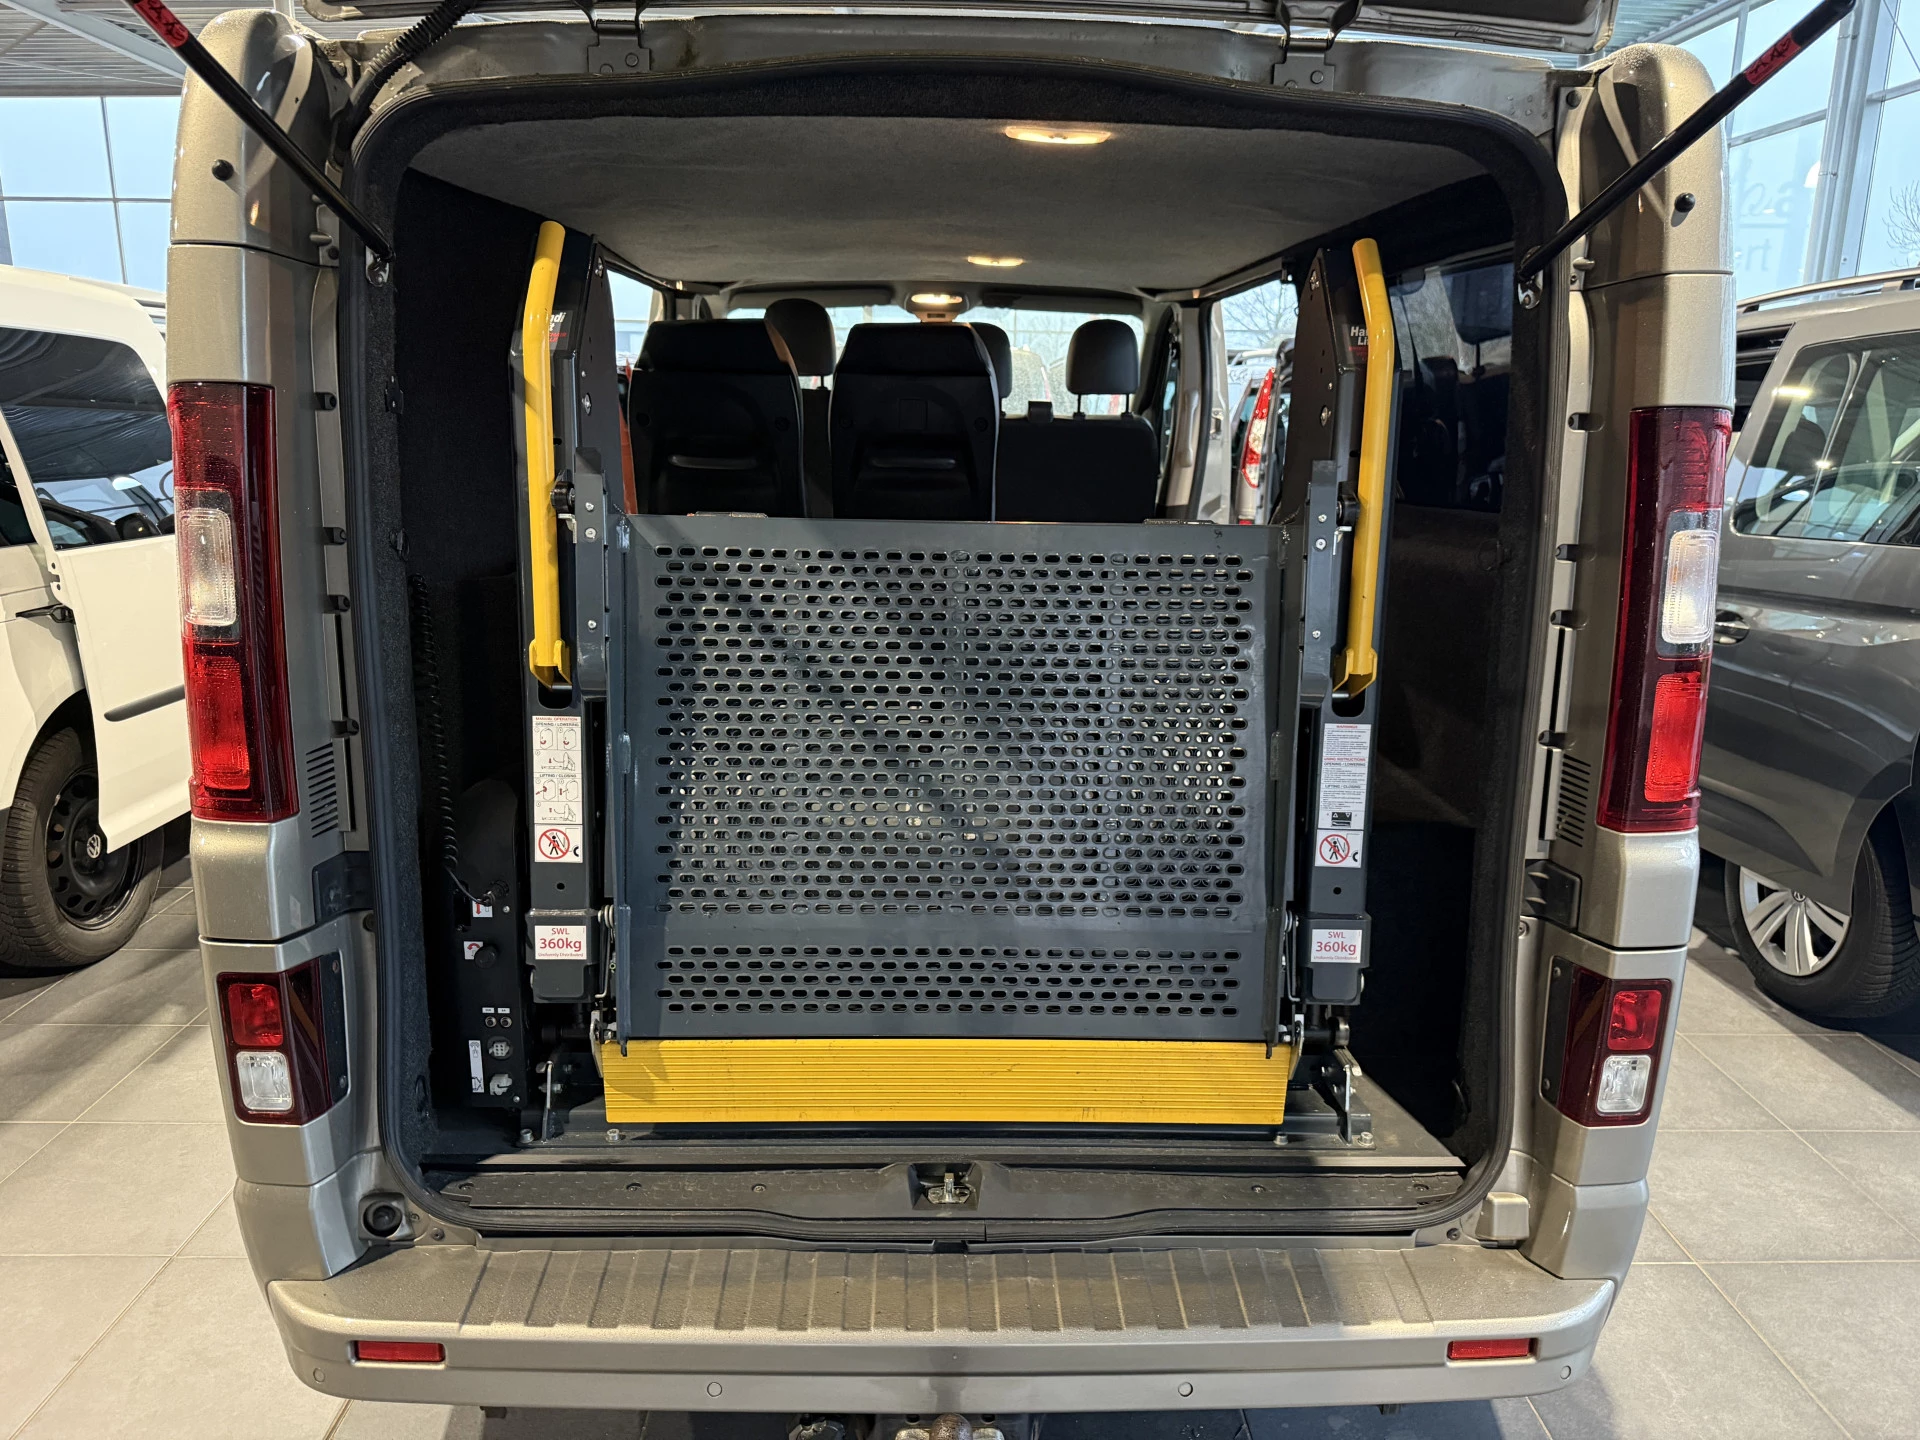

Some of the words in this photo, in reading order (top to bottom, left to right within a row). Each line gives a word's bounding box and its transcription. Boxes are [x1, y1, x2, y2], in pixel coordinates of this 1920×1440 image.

[551, 927, 570, 935] SWL
[1327, 931, 1346, 939] SWL
[539, 937, 582, 952] 360kg
[1315, 941, 1357, 955] 360kg
